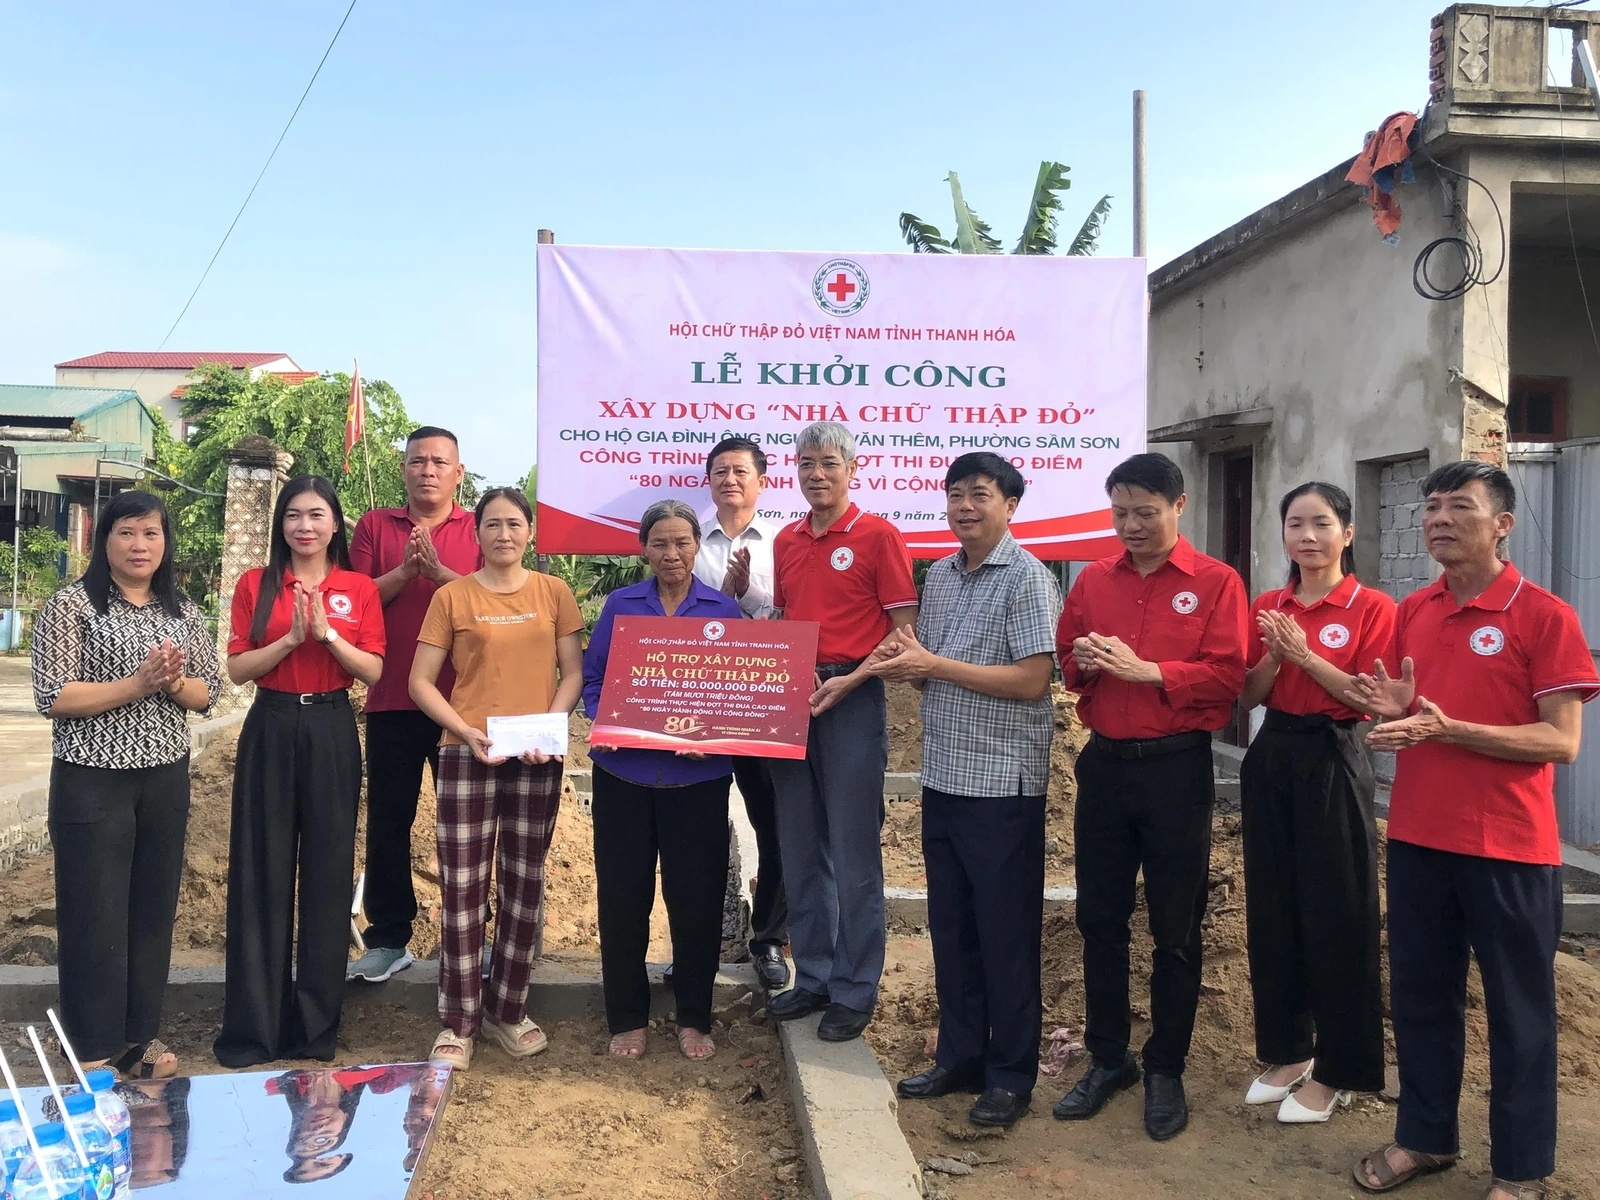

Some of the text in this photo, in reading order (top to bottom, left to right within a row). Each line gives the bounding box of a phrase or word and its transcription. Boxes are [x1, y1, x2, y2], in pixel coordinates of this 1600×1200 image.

[669, 321, 1016, 342] HỘI CHỮ THẬP ĐỎ VIỆT NAM TỈNH THANH HÓA
[691, 352, 1006, 388] LỄ KHỞI CÔNG
[598, 397, 656, 419] XÂY
[666, 402, 756, 424] DỰNG
[859, 402, 930, 424] CHỮ
[944, 403, 1028, 428] THẬP
[1037, 402, 1096, 425] ĐỎ”
[560, 430, 600, 441] CHO
[606, 428, 632, 445] HỘ
[637, 430, 668, 442] GIA
[672, 429, 716, 443] ĐÌNH
[890, 433, 944, 449] THÊM,
[950, 434, 1030, 448] PHƯỜNG
[1036, 432, 1076, 448] SẦM
[1080, 434, 1120, 449] SƠN
[580, 448, 642, 464] CÔNG
[856, 454, 884, 470] ỢT
[890, 456, 922, 468] THI
[1032, 454, 1082, 470] ĐIỂM
[630, 474, 662, 487] “80
[670, 472, 710, 488] NGÀ
[868, 475, 886, 490] VÌ
[757, 509, 785, 519] Sơn,
[893, 511, 900, 520] 9
[904, 511, 935, 520] năm
[646, 651, 777, 668] HỖ TRỢ XÂY DỰNG
[630, 664, 790, 684] NHÀ CHỮ THẬP ĐỎ
[631, 676, 784, 694] SỐ TIỀN: 80.000.000 ĐỒNG
[689, 700, 706, 708] HIỆN
[706, 692, 728, 700] TRIỆU
[664, 716, 695, 732] 80
